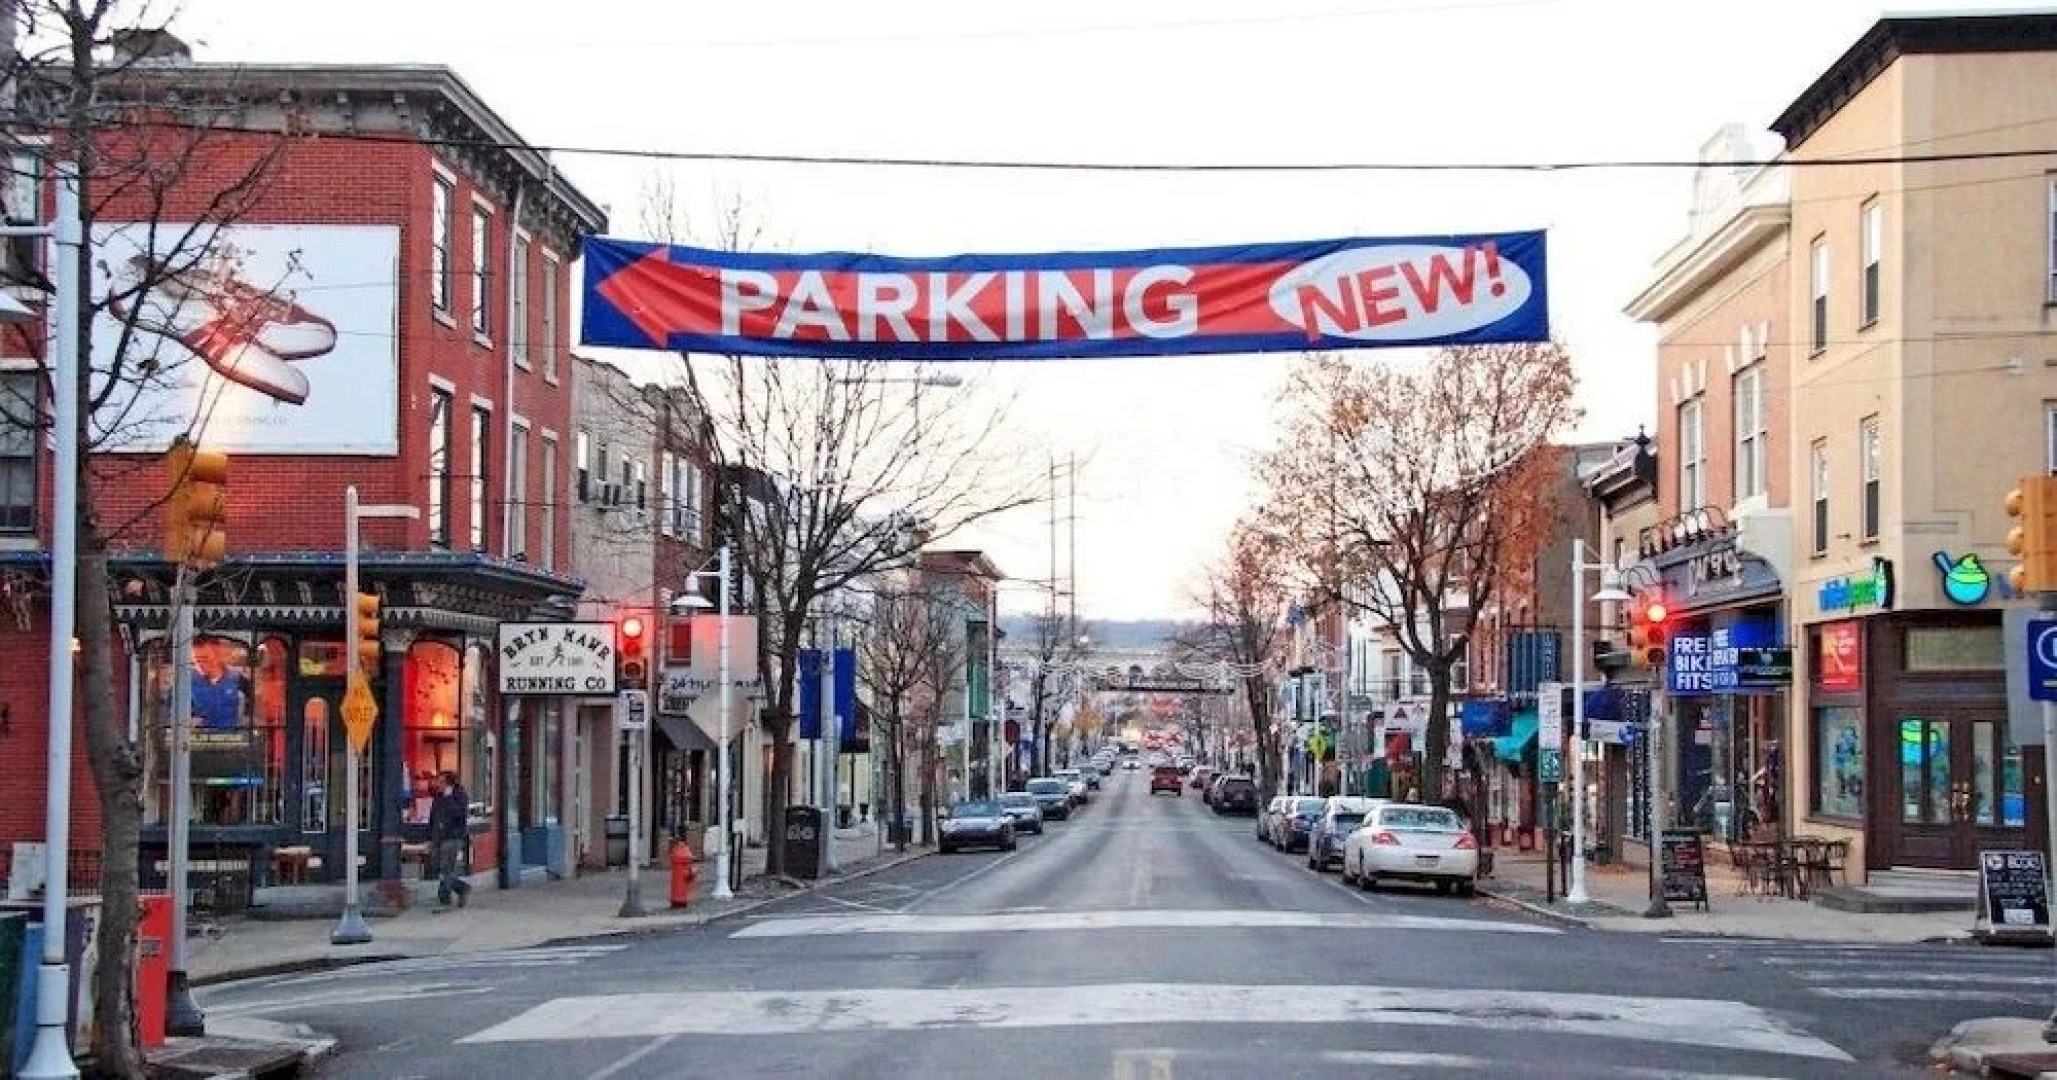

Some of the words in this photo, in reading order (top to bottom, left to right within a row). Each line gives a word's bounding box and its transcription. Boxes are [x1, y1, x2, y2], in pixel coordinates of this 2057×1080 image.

[719, 264, 1199, 342] PARKING
[1297, 240, 1506, 343] NEW!
[503, 626, 548, 659] BRYN
[563, 626, 610, 661] MAWR
[506, 676, 575, 690] RUNNING
[585, 676, 606, 690] CO
